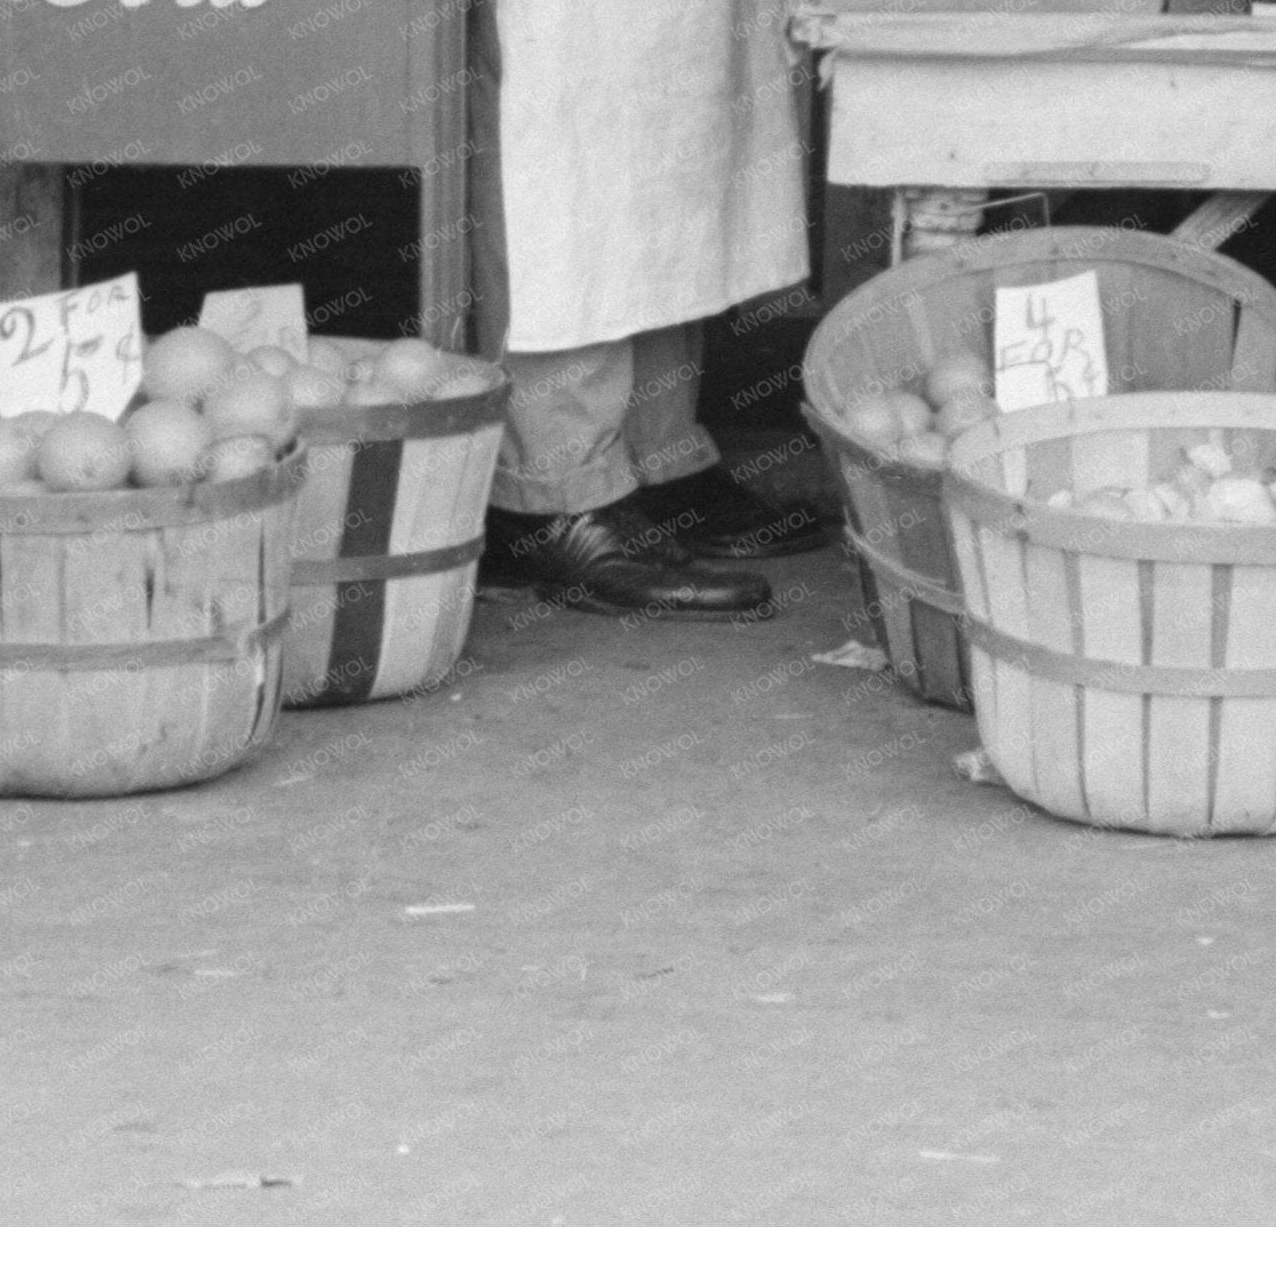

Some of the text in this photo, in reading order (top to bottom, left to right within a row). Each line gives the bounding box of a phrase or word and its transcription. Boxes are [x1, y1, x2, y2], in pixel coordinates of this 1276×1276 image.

[55, 283, 130, 332] FOR
[1025, 292, 1057, 341] 4
[996, 327, 1092, 372] FOR
